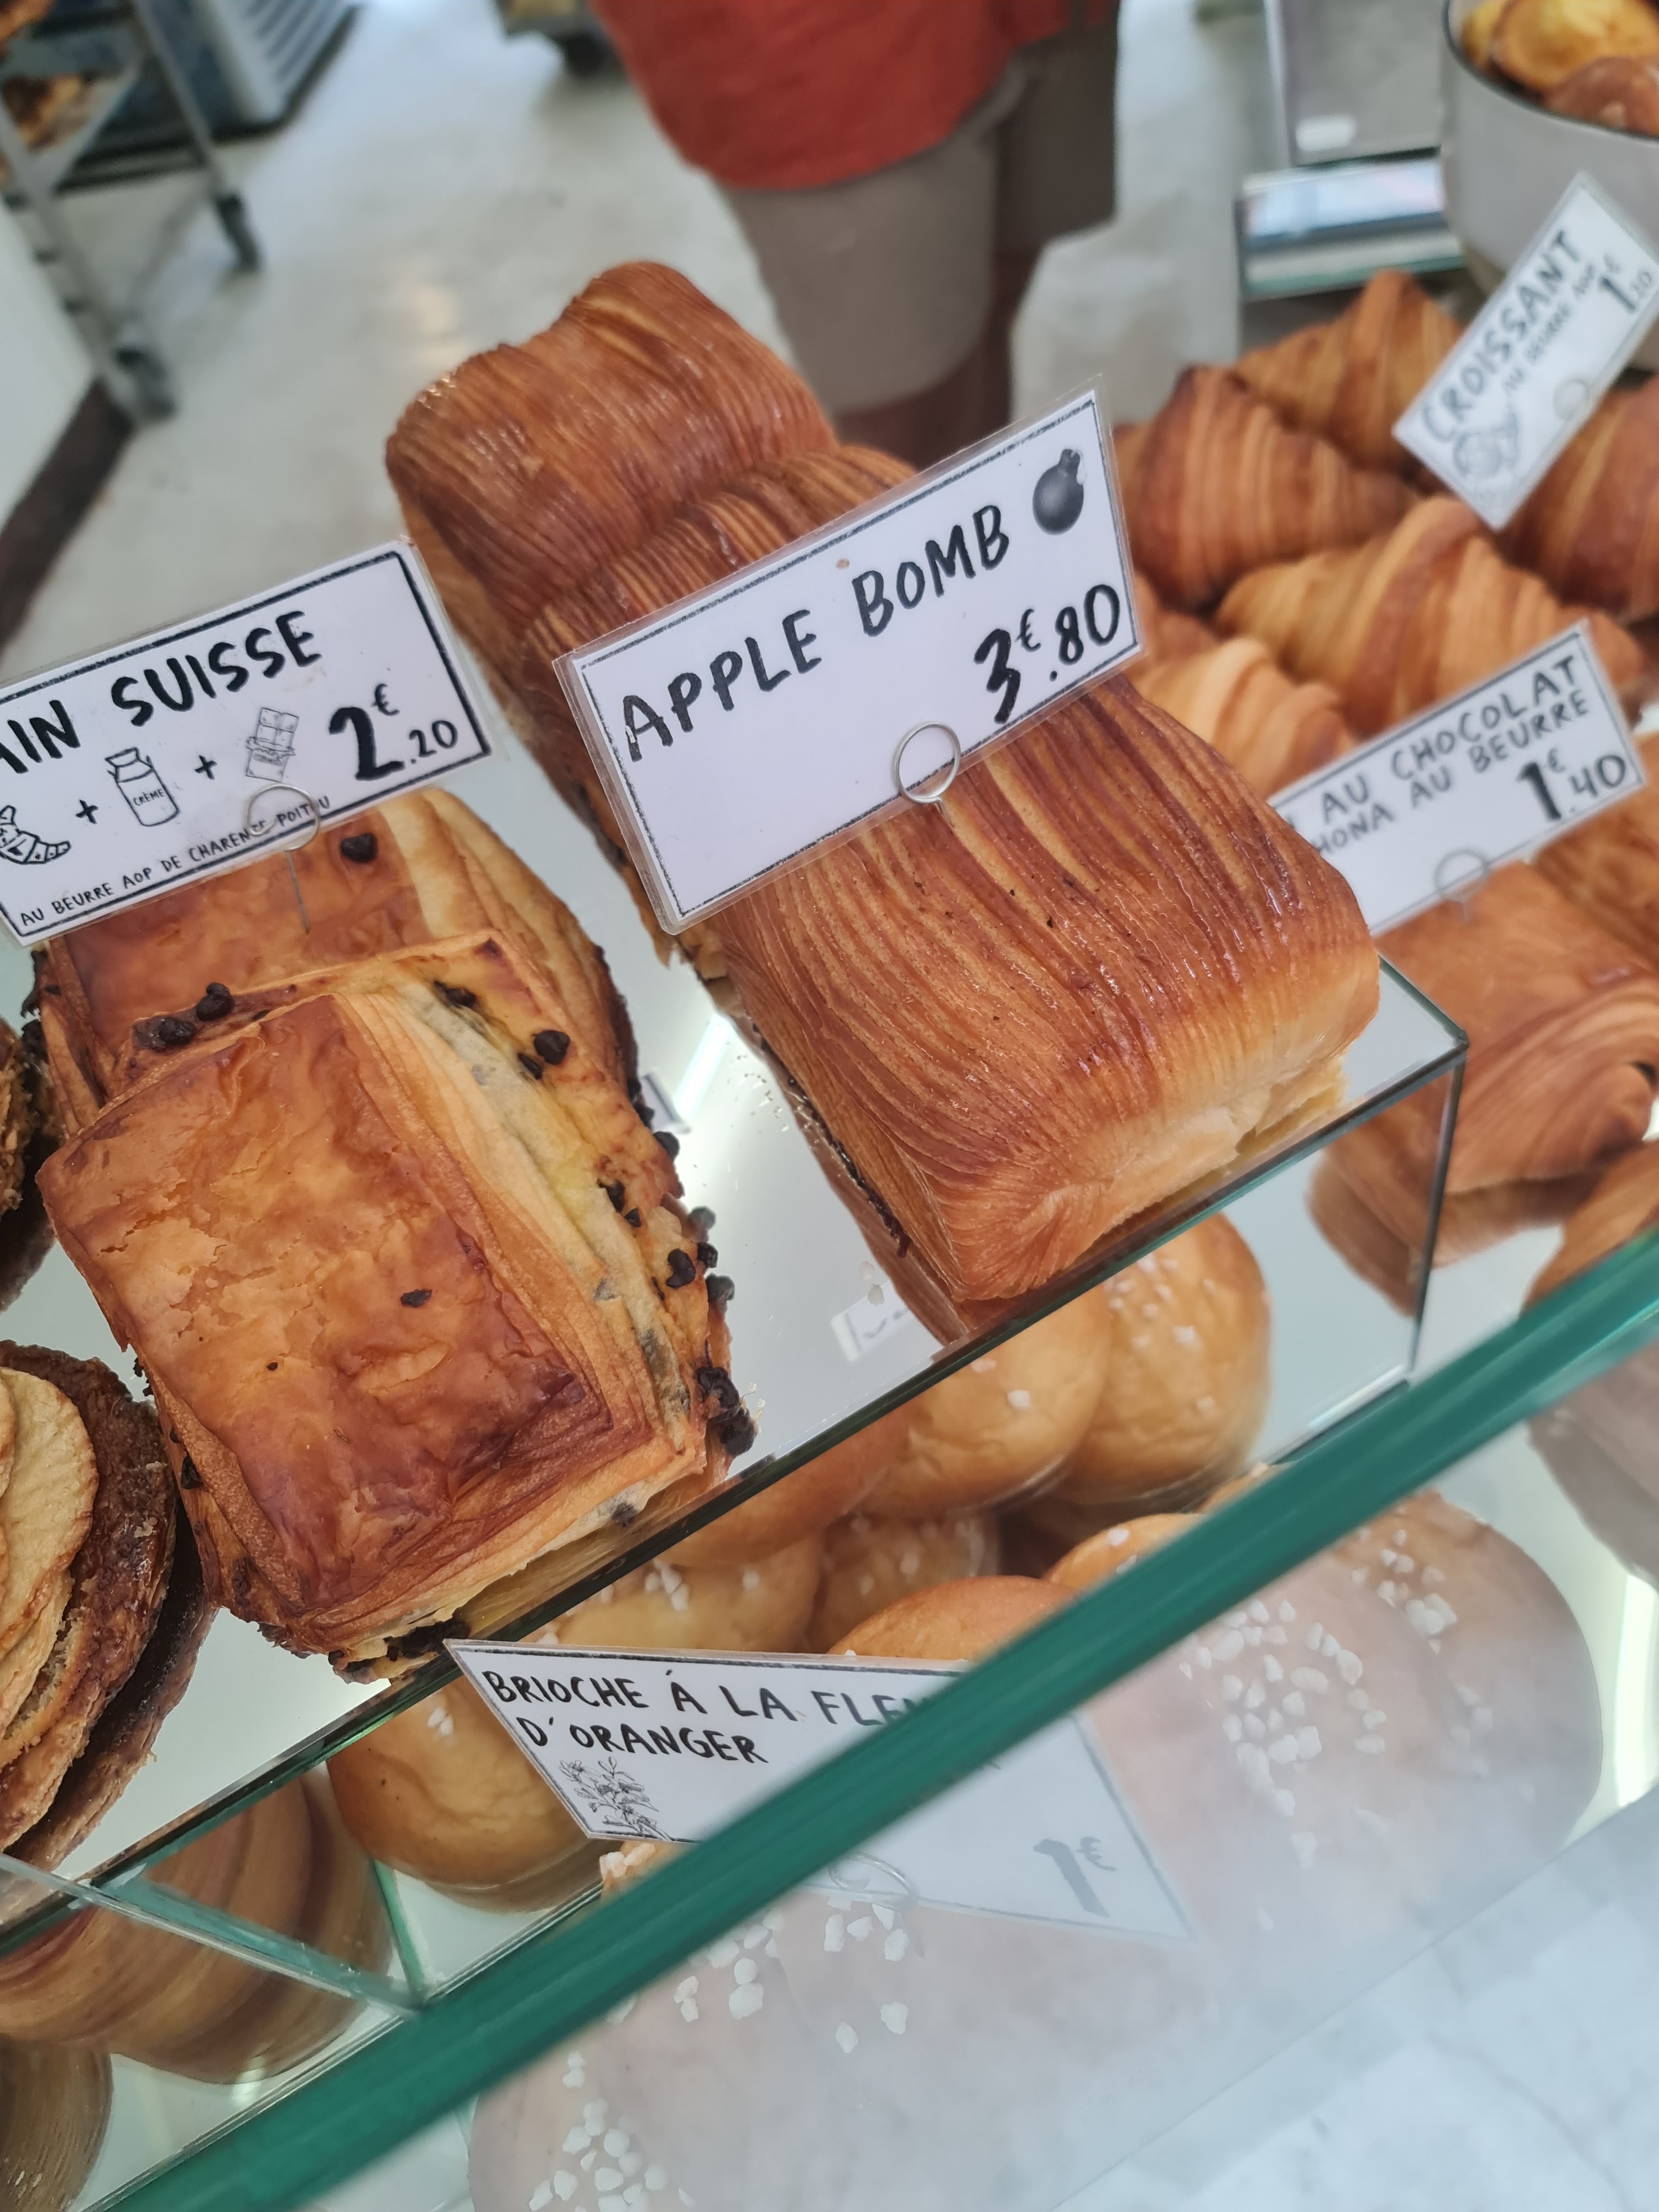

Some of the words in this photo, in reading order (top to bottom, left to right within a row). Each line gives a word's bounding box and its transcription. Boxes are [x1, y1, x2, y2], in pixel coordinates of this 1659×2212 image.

[1421, 231, 1579, 442] CROISSANT
[112, 611, 322, 727] SUISSE
[622, 609, 822, 762] APPLE
[851, 504, 1010, 637] BOMB
[1322, 774, 1369, 823] AU
[1390, 655, 1575, 779] CHOCOLAT
[1411, 765, 1451, 808] AU
[1468, 689, 1589, 774] BEURRE
[20, 908, 44, 926] AU
[51, 883, 114, 914] BEURRE
[123, 867, 152, 889] AOP
[160, 855, 181, 872] DE
[276, 795, 330, 826] POITU
[482, 1671, 649, 1708] BRIOCHE
[718, 1685, 797, 1722] LA
[812, 1691, 935, 1729] FLE
